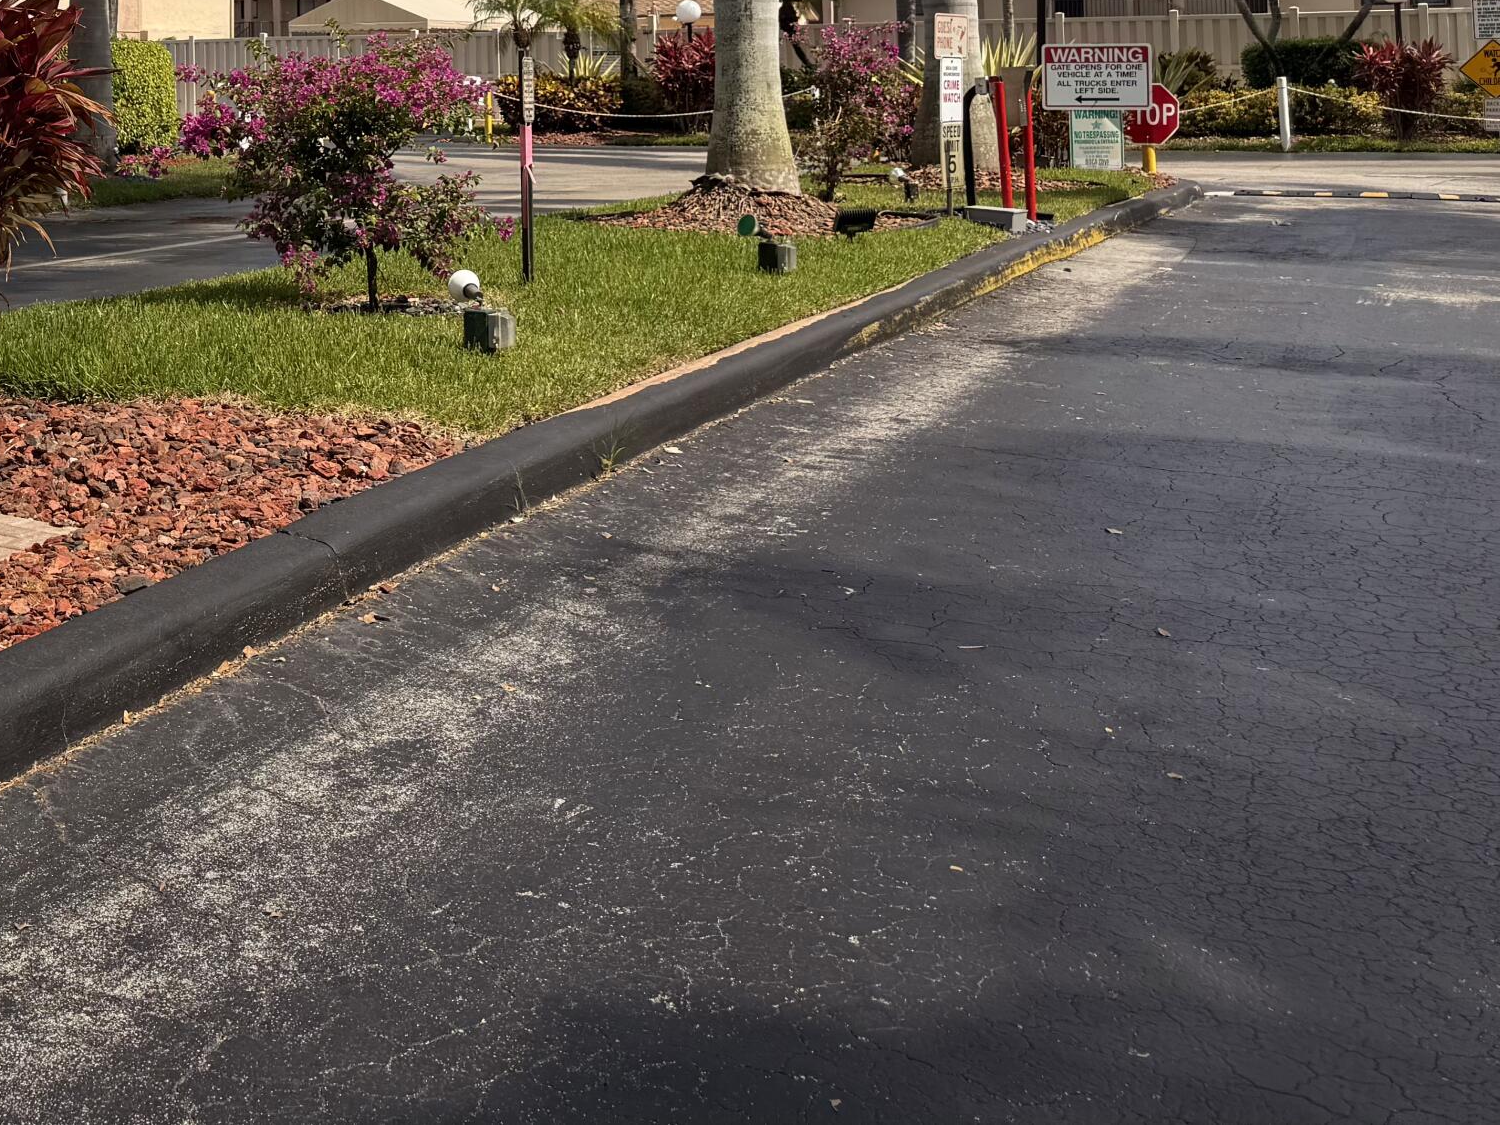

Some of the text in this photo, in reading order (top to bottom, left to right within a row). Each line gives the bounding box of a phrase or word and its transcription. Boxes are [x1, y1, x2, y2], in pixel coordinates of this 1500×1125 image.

[937, 37, 952, 49] PHONE
[1050, 47, 1143, 63] WARNING
[943, 80, 960, 90] CRIME
[943, 93, 961, 103] WATCH
[1074, 110, 1118, 119] WARNING!
[1137, 103, 1176, 126] TOP
[942, 125, 961, 138] SPEED
[1074, 131, 1120, 139] NO TRESPASSING
